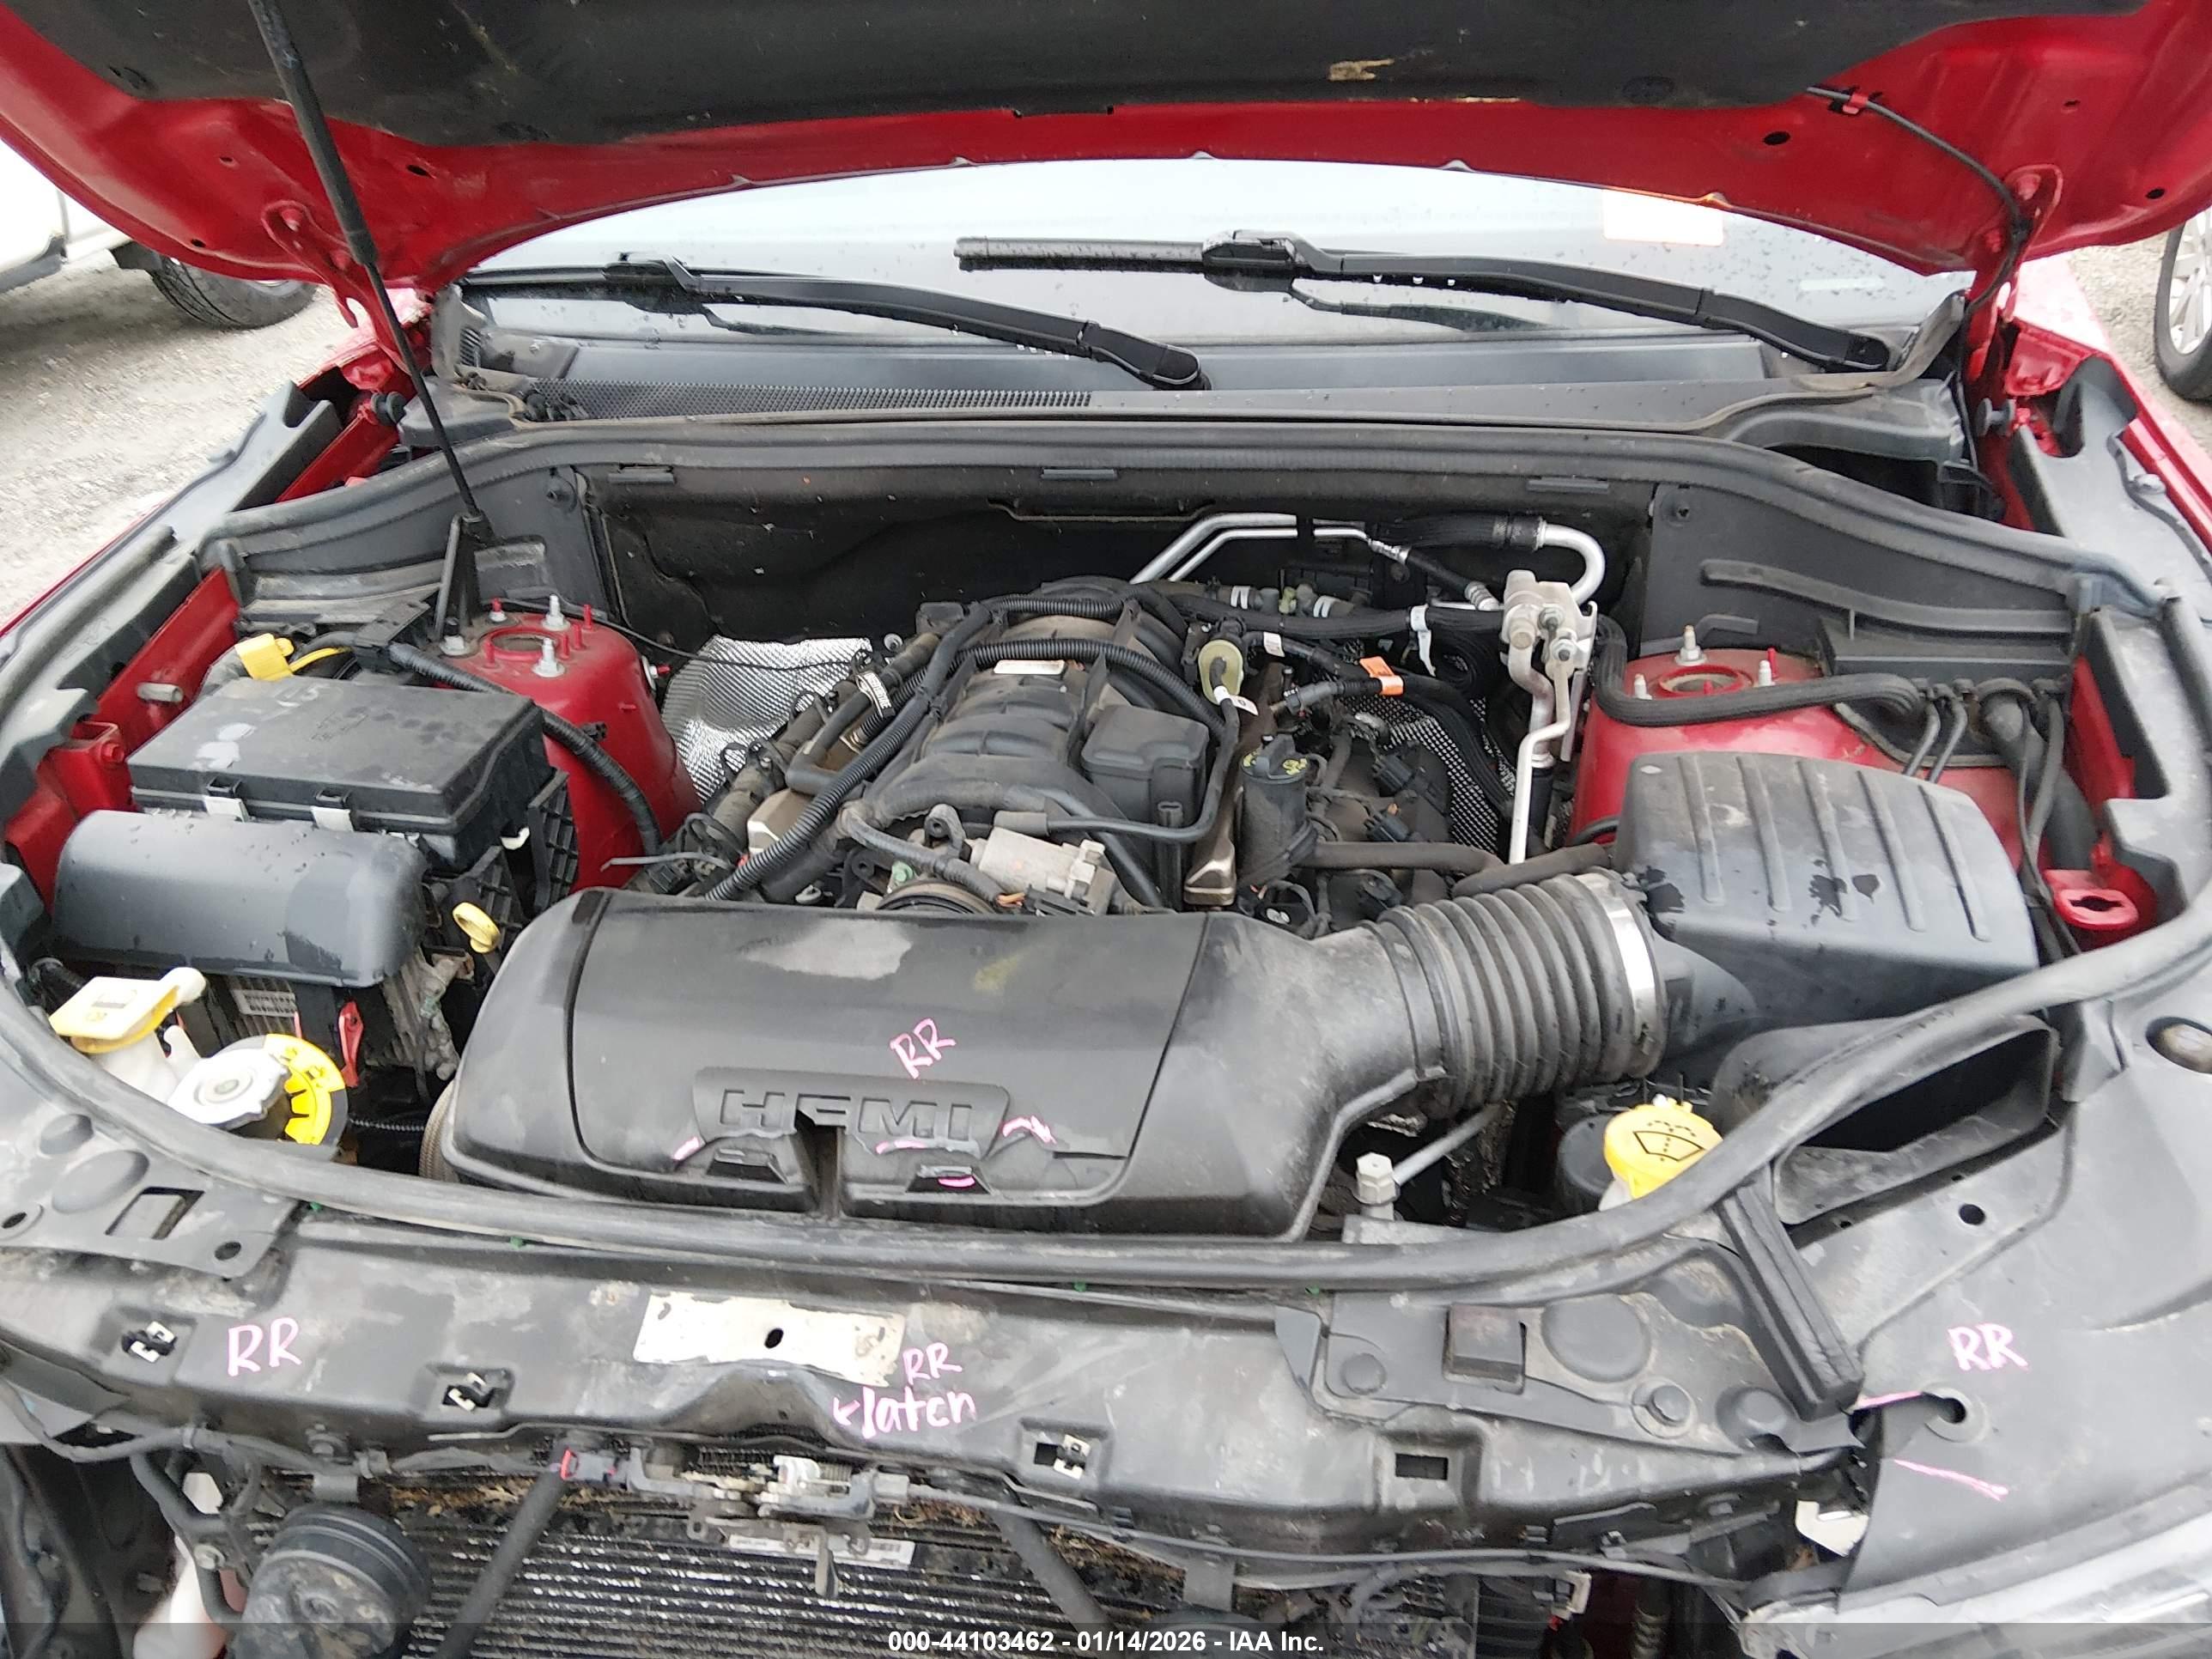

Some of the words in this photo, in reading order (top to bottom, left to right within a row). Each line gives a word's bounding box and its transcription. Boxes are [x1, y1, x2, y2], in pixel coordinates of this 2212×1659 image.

[890, 1018, 957, 1079] RR
[228, 1317, 302, 1376] RR
[902, 1342, 963, 1385] RR
[1948, 1322, 2030, 1371] RR
